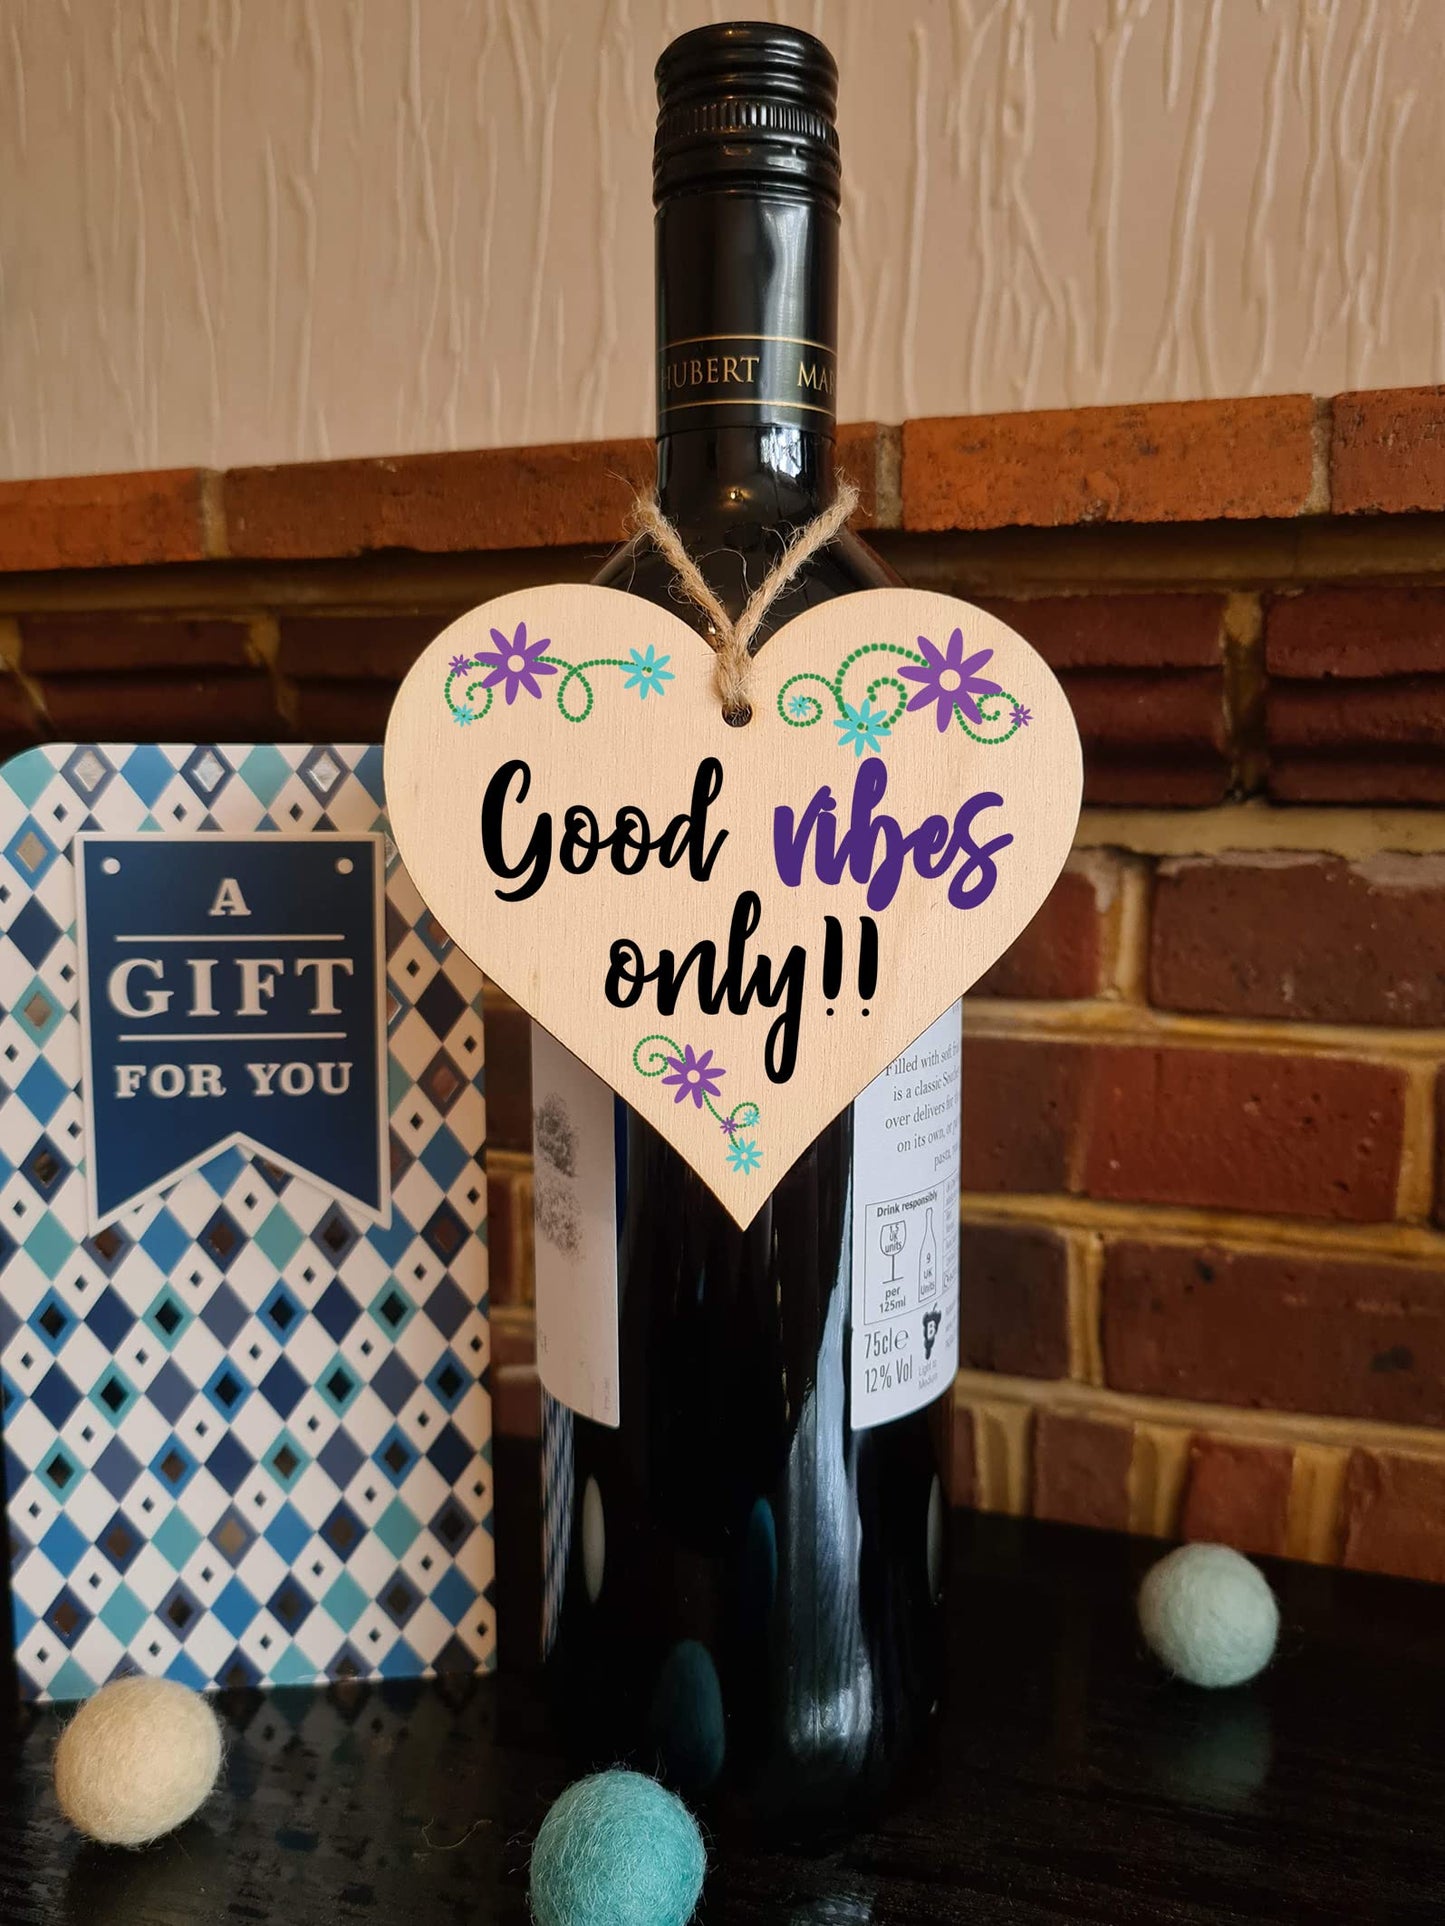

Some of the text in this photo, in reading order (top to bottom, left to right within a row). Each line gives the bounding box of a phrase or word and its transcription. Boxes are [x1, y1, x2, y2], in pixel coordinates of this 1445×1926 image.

[660, 356, 760, 392] HUBERT
[481, 756, 1014, 912] Good vibes
[208, 878, 252, 917] A
[107, 958, 354, 1018] GIFT
[604, 890, 879, 1084] only!!
[921, 1050, 940, 1068] with
[113, 1062, 352, 1098] FOR YOU
[893, 1085, 903, 1101] is
[906, 1088, 912, 1099] a
[914, 1074, 942, 1097] classic
[885, 1111, 911, 1130] over
[913, 1101, 946, 1123] delivers
[897, 1141, 911, 1153] on
[914, 1132, 926, 1149] its
[876, 1204, 900, 1218] Drink
[901, 1191, 938, 1211] responsibly
[885, 1241, 902, 1253] units
[889, 1231, 898, 1242] UK
[879, 1296, 906, 1314] 125ml
[885, 1287, 901, 1300] per
[865, 1354, 913, 1394] 12% Vol
